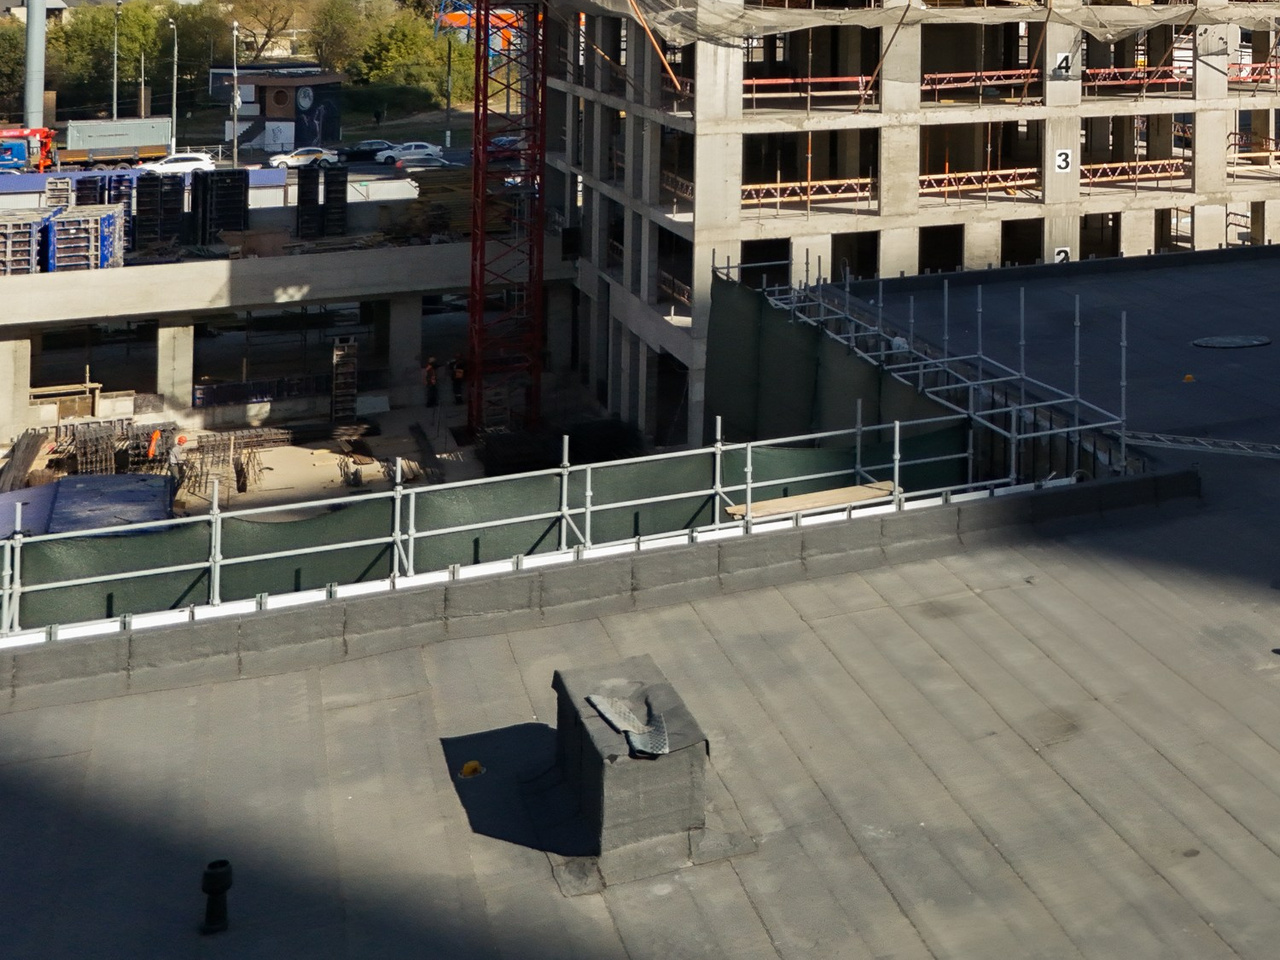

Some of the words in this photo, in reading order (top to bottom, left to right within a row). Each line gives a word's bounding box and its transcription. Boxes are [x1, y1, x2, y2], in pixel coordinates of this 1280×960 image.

[1057, 54, 1071, 73] 4
[1056, 151, 1070, 170] 3
[1055, 249, 1070, 263] 2
